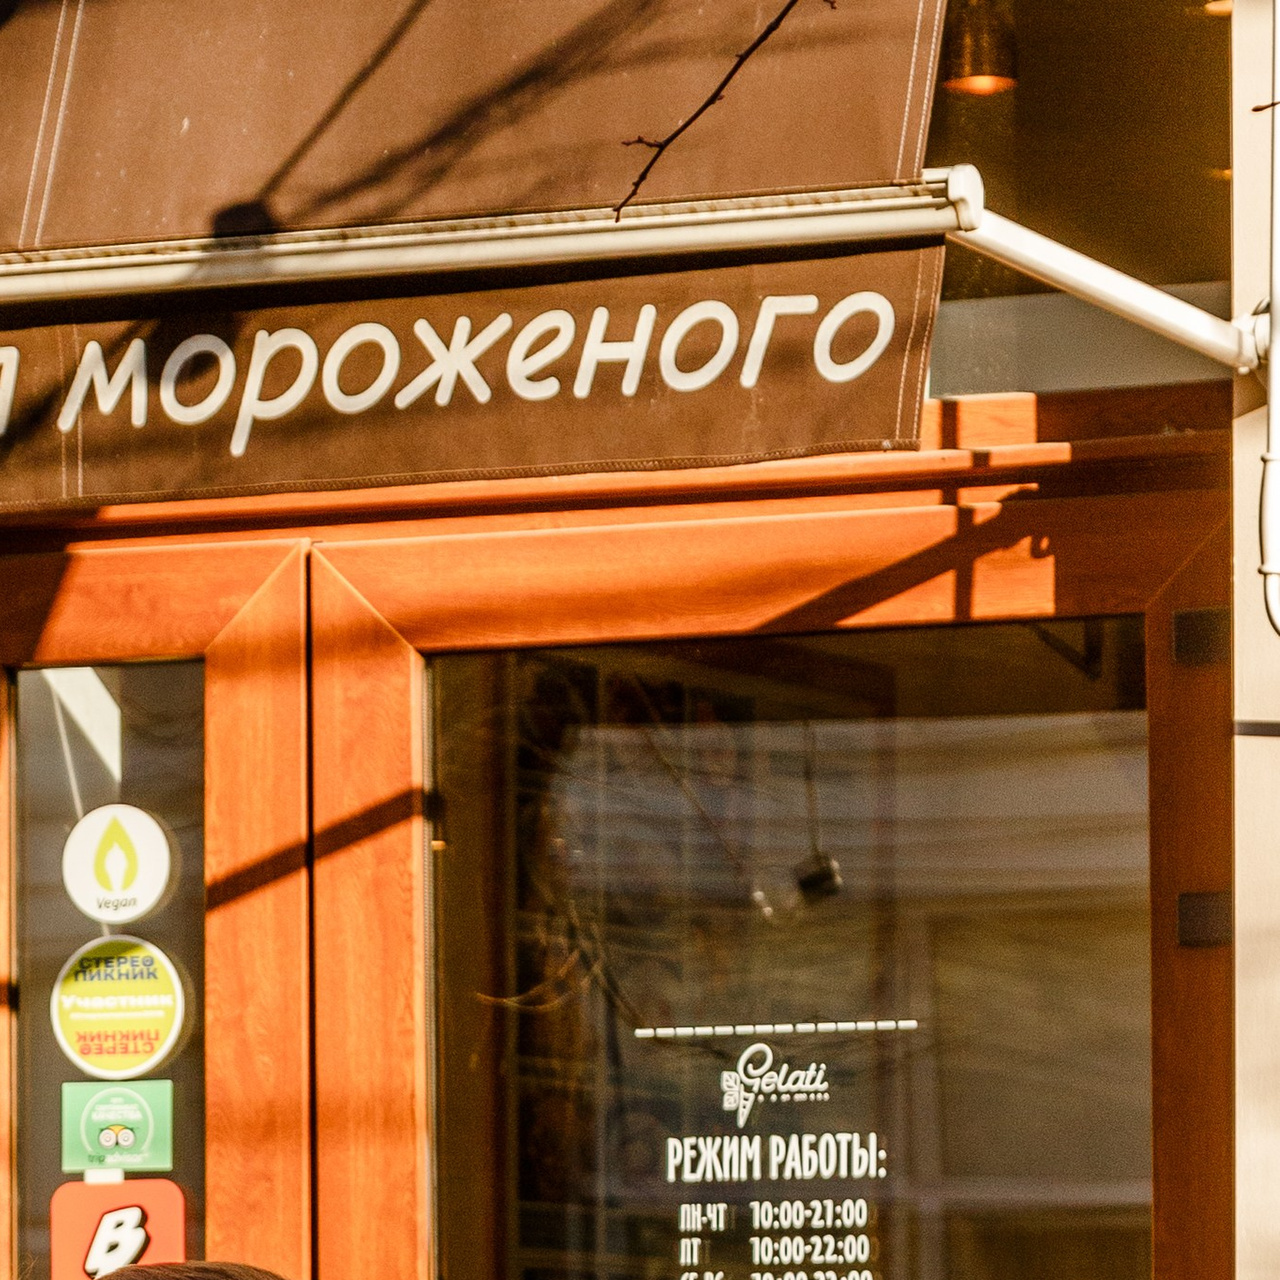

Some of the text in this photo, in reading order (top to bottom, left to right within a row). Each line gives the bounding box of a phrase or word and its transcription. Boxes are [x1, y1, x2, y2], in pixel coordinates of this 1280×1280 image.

[57, 290, 895, 457] мороженого
[74, 967, 159, 981] ПИКНИК
[737, 1043, 829, 1093] Gelati
[666, 1132, 887, 1183] РЕЖИМ РАБОТЫ:
[679, 1198, 868, 1232] ПН-ЧТ 10:00-21:00
[679, 1234, 870, 1267] ПТ 10:00-22:00
